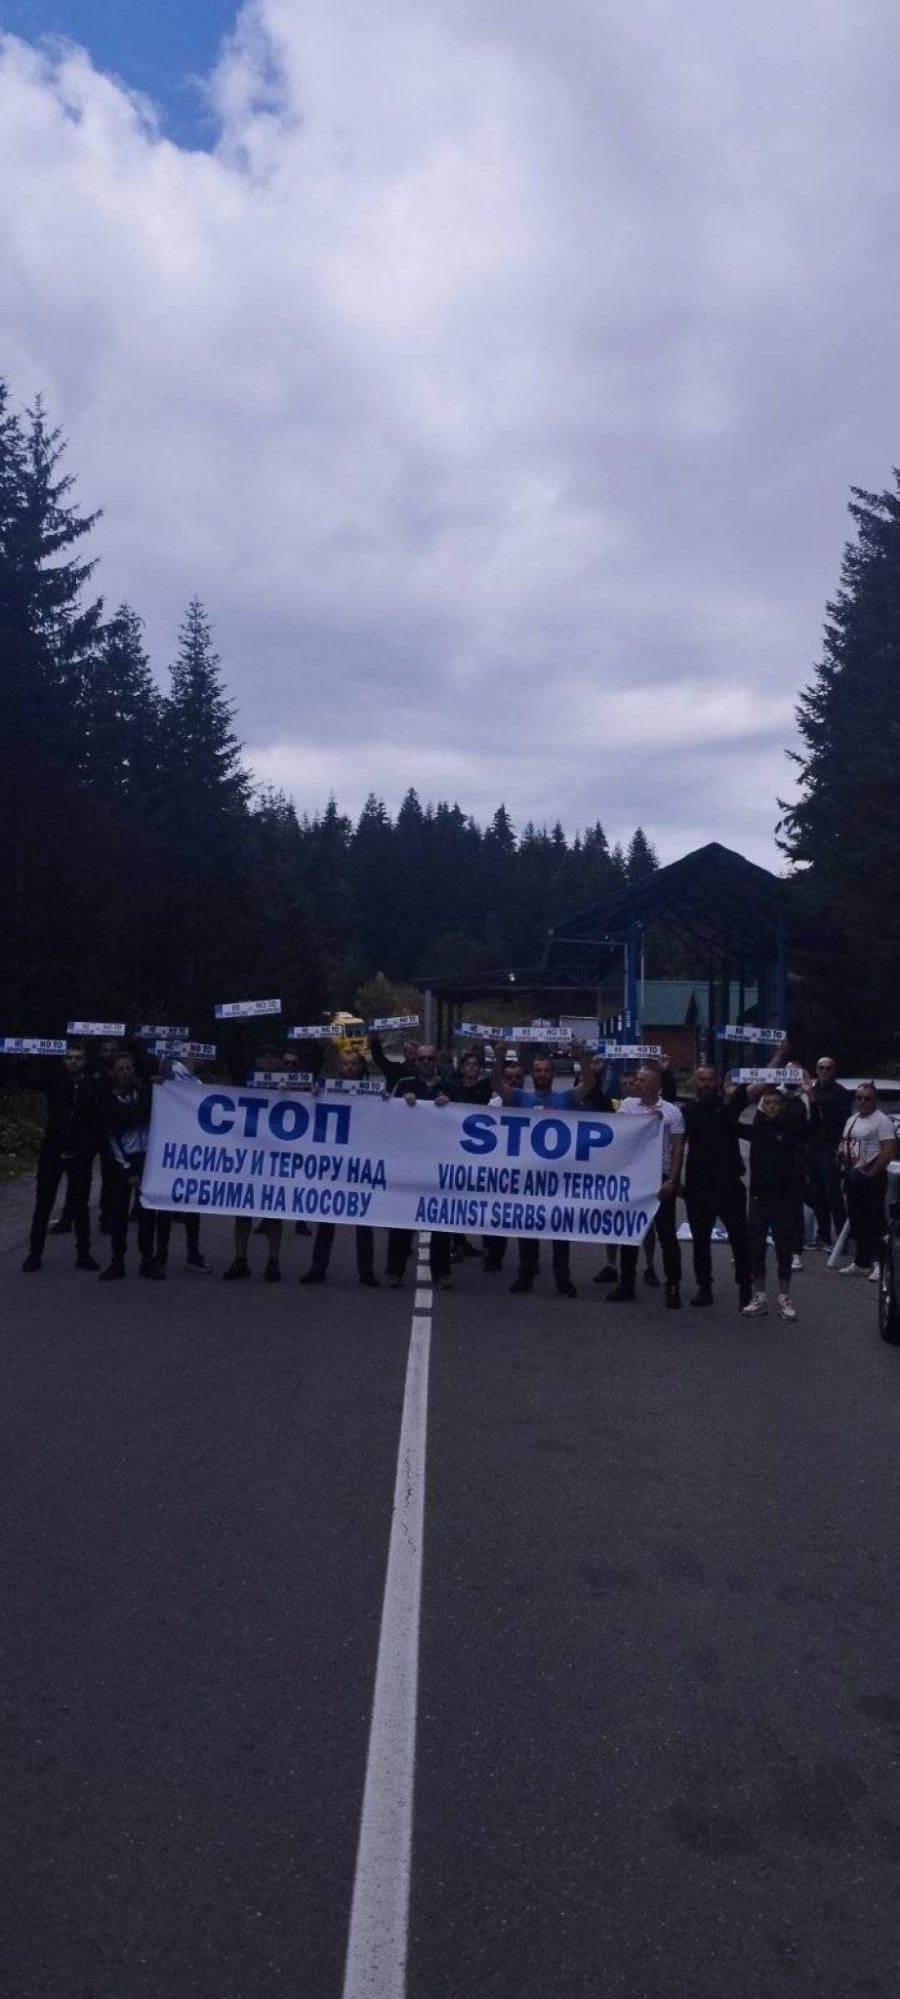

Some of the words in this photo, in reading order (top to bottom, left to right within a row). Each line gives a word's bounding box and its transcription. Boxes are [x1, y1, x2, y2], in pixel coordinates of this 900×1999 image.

[268, 1000, 276, 1008] TO
[491, 1027, 501, 1035] NO
[760, 1029, 771, 1038] NO
[773, 1030, 782, 1039] TO
[39, 1040, 51, 1049] NO
[53, 1041, 63, 1049] TO
[190, 1043, 201, 1052] NO
[203, 1044, 212, 1053] TO
[288, 1073, 299, 1081] NO
[300, 1073, 310, 1081] TO
[775, 1069, 787, 1077] NO
[789, 1069, 799, 1077] TO
[359, 1081, 370, 1089] NO
[371, 1082, 381, 1090] TO
[197, 1094, 352, 1145] СТОП
[459, 1114, 614, 1161] STOP
[162, 1142, 248, 1174] НАСИЉУ
[250, 1150, 265, 1176] И
[269, 1151, 343, 1181] ТЕРОРУ
[346, 1157, 387, 1190] НАД
[438, 1163, 520, 1194] VIOLENCE
[523, 1169, 559, 1197] AND
[563, 1172, 631, 1202] TERROR
[171, 1177, 254, 1209] СРБИМА
[260, 1184, 287, 1211] НА
[292, 1187, 372, 1217] КОСОВУ
[415, 1197, 488, 1227] AGAINST
[490, 1202, 546, 1231] SERBS
[550, 1206, 574, 1231] ON
